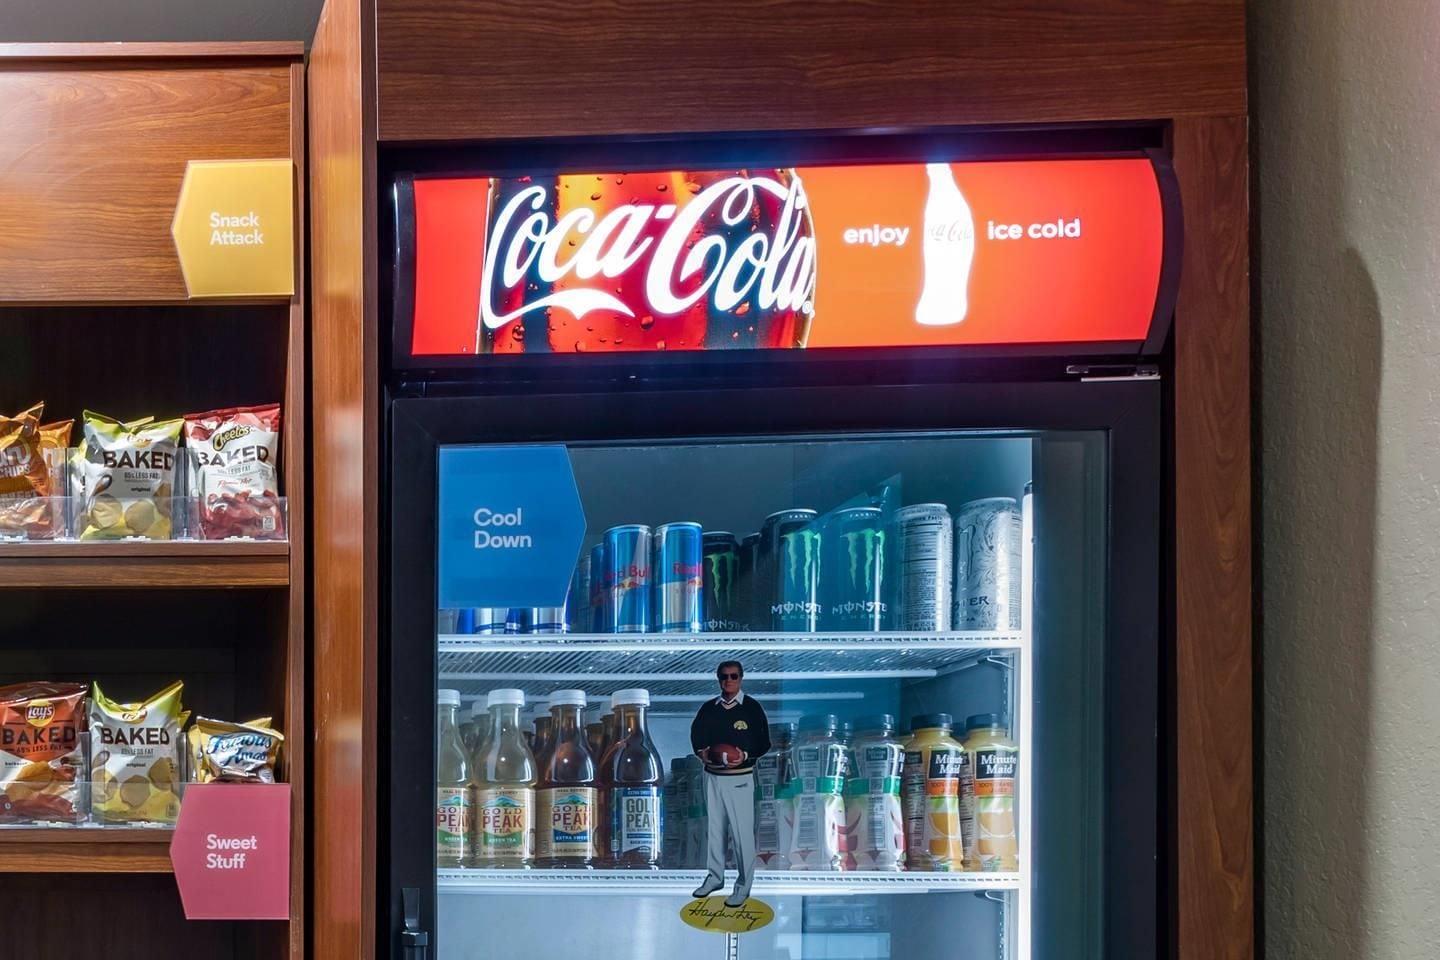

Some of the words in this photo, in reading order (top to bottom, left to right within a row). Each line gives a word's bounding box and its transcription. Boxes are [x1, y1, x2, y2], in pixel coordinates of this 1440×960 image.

[210, 211, 259, 228] Snack
[210, 230, 264, 246] Attack
[843, 224, 910, 247] enjoy
[987, 220, 1023, 240] ice
[1027, 218, 1081, 239] cold
[482, 177, 816, 330] Coca-Cola
[213, 426, 250, 451] Cheetos
[103, 450, 175, 471] BAKED
[199, 445, 269, 467] BAKED
[473, 507, 522, 527] Cool
[474, 530, 532, 549] Down
[2, 726, 76, 746] BAKED
[100, 727, 170, 746] BAKED
[986, 763, 1014, 775] Maid
[482, 807, 523, 815] GOLD
[482, 815, 523, 828] PEAK
[206, 834, 258, 850] Sweet
[206, 853, 246, 869] Stuff
